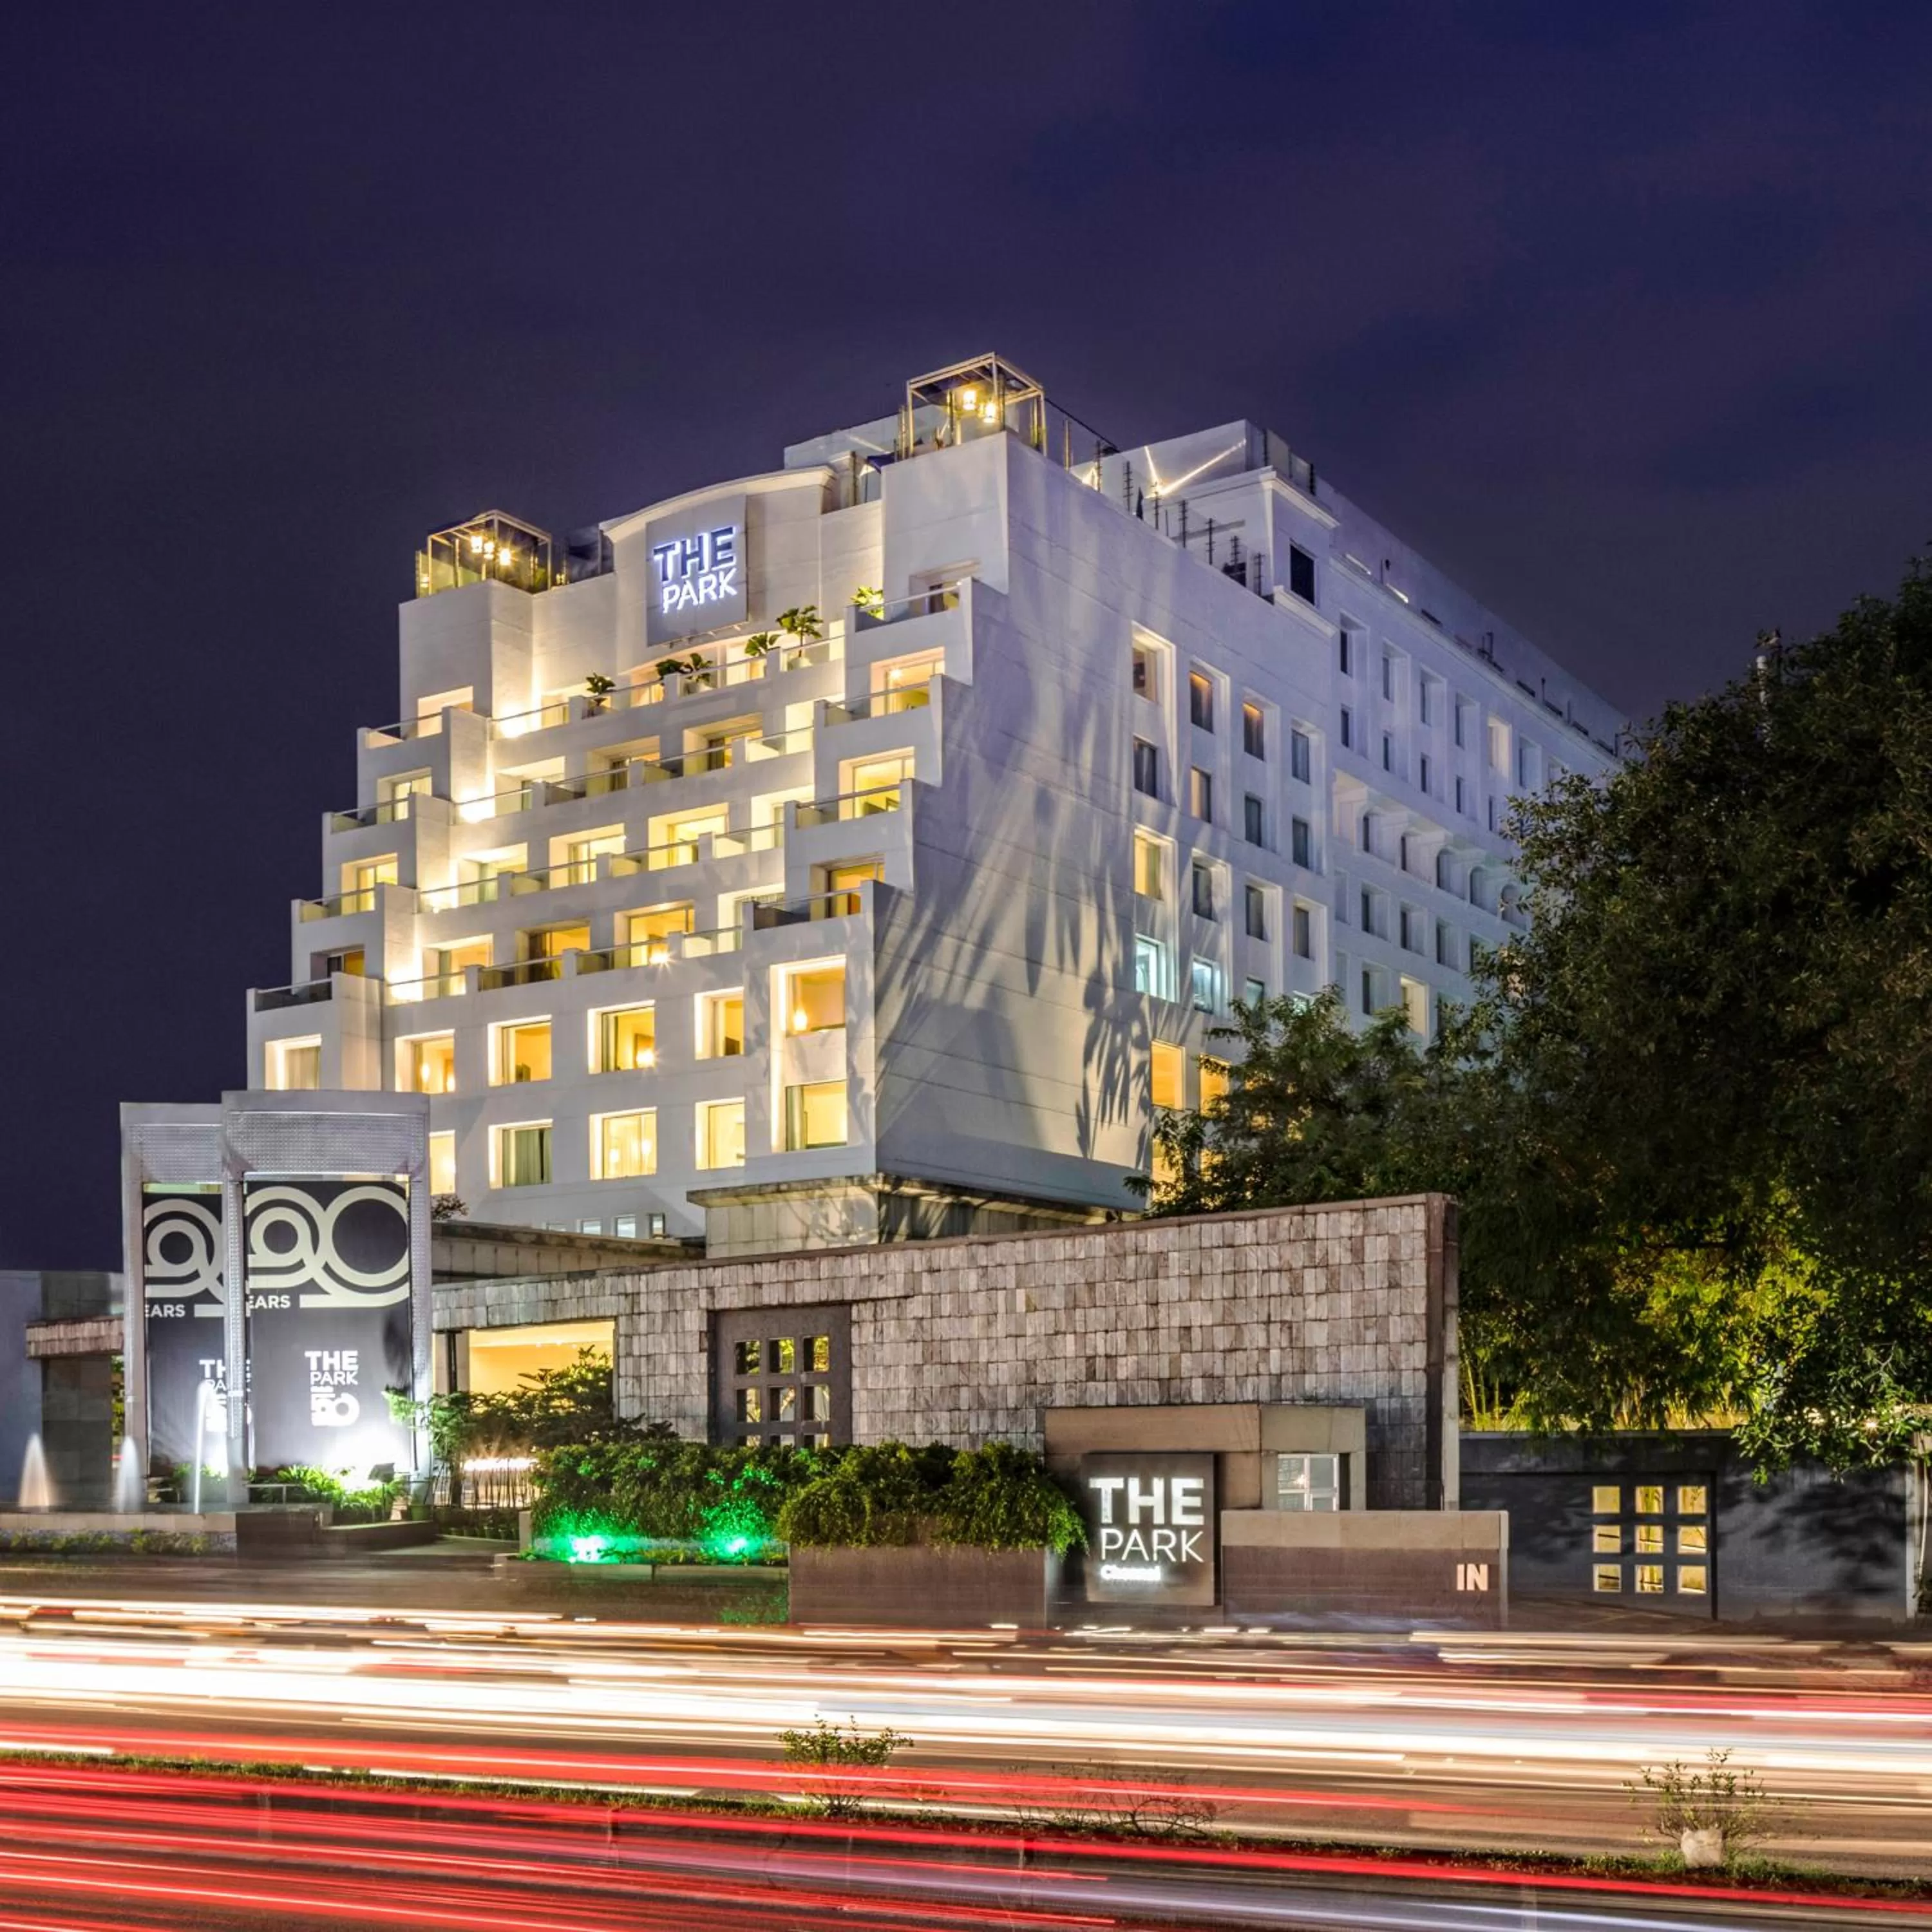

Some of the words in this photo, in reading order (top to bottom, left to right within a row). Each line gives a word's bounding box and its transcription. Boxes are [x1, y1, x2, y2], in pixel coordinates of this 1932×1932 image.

[652, 526, 736, 585] THE
[661, 567, 737, 614] PARK
[305, 1350, 359, 1371] THE
[310, 1371, 359, 1385] PARK
[1089, 1477, 1204, 1525] THE
[1101, 1528, 1204, 1562] PARK
[1457, 1564, 1488, 1591] IN
